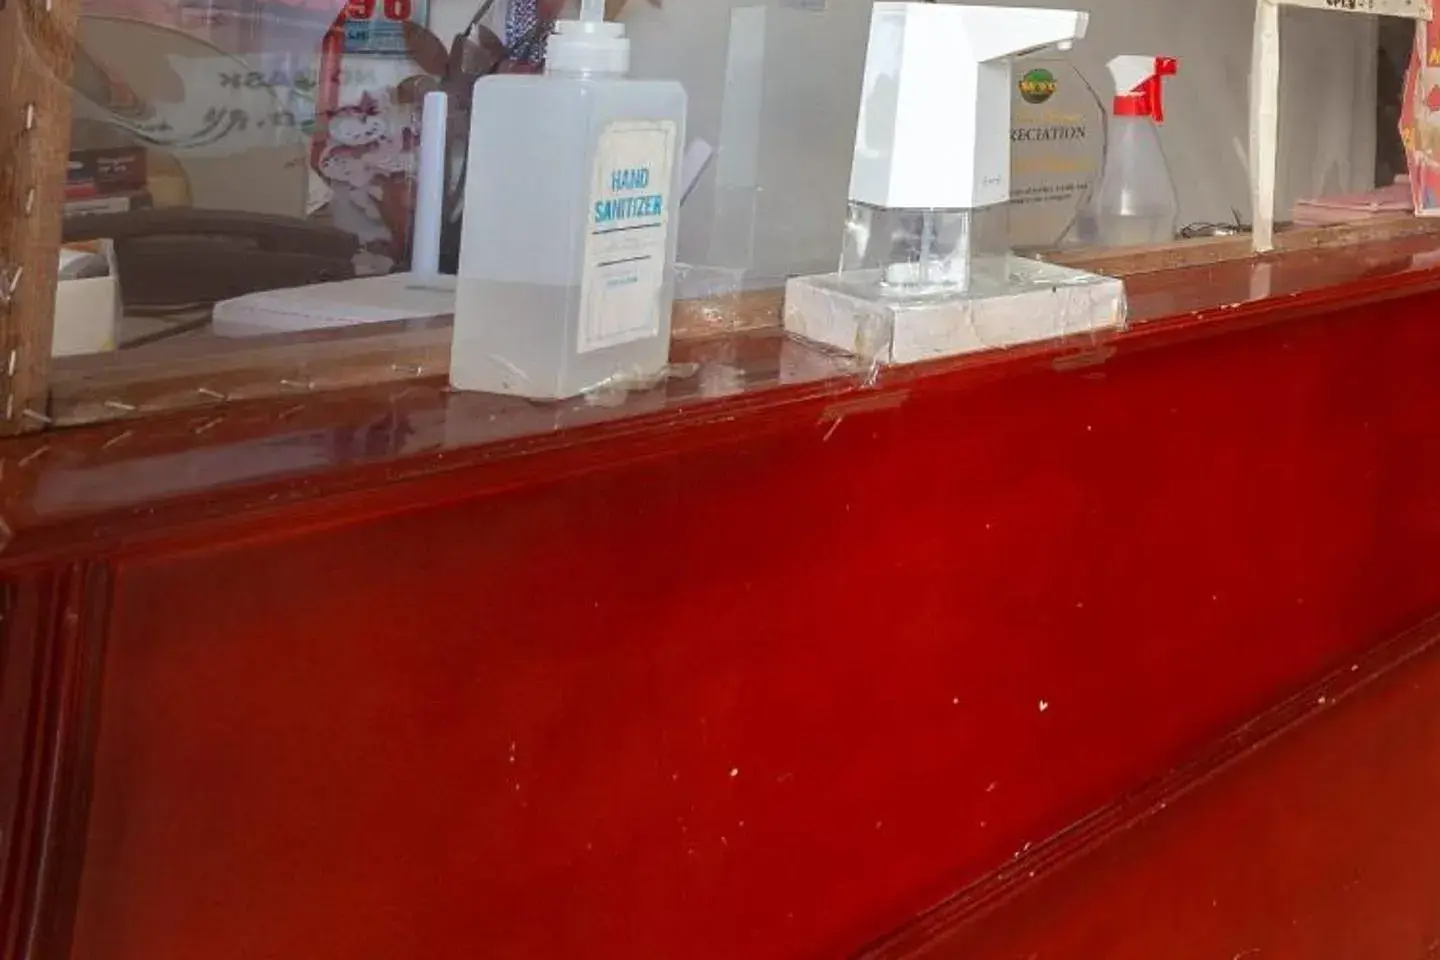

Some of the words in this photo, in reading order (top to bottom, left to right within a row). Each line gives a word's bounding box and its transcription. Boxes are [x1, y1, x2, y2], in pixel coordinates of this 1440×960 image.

[1010, 126, 1086, 142] RECIATION
[612, 168, 649, 191] HAND
[594, 195, 662, 223] SANITIZER
